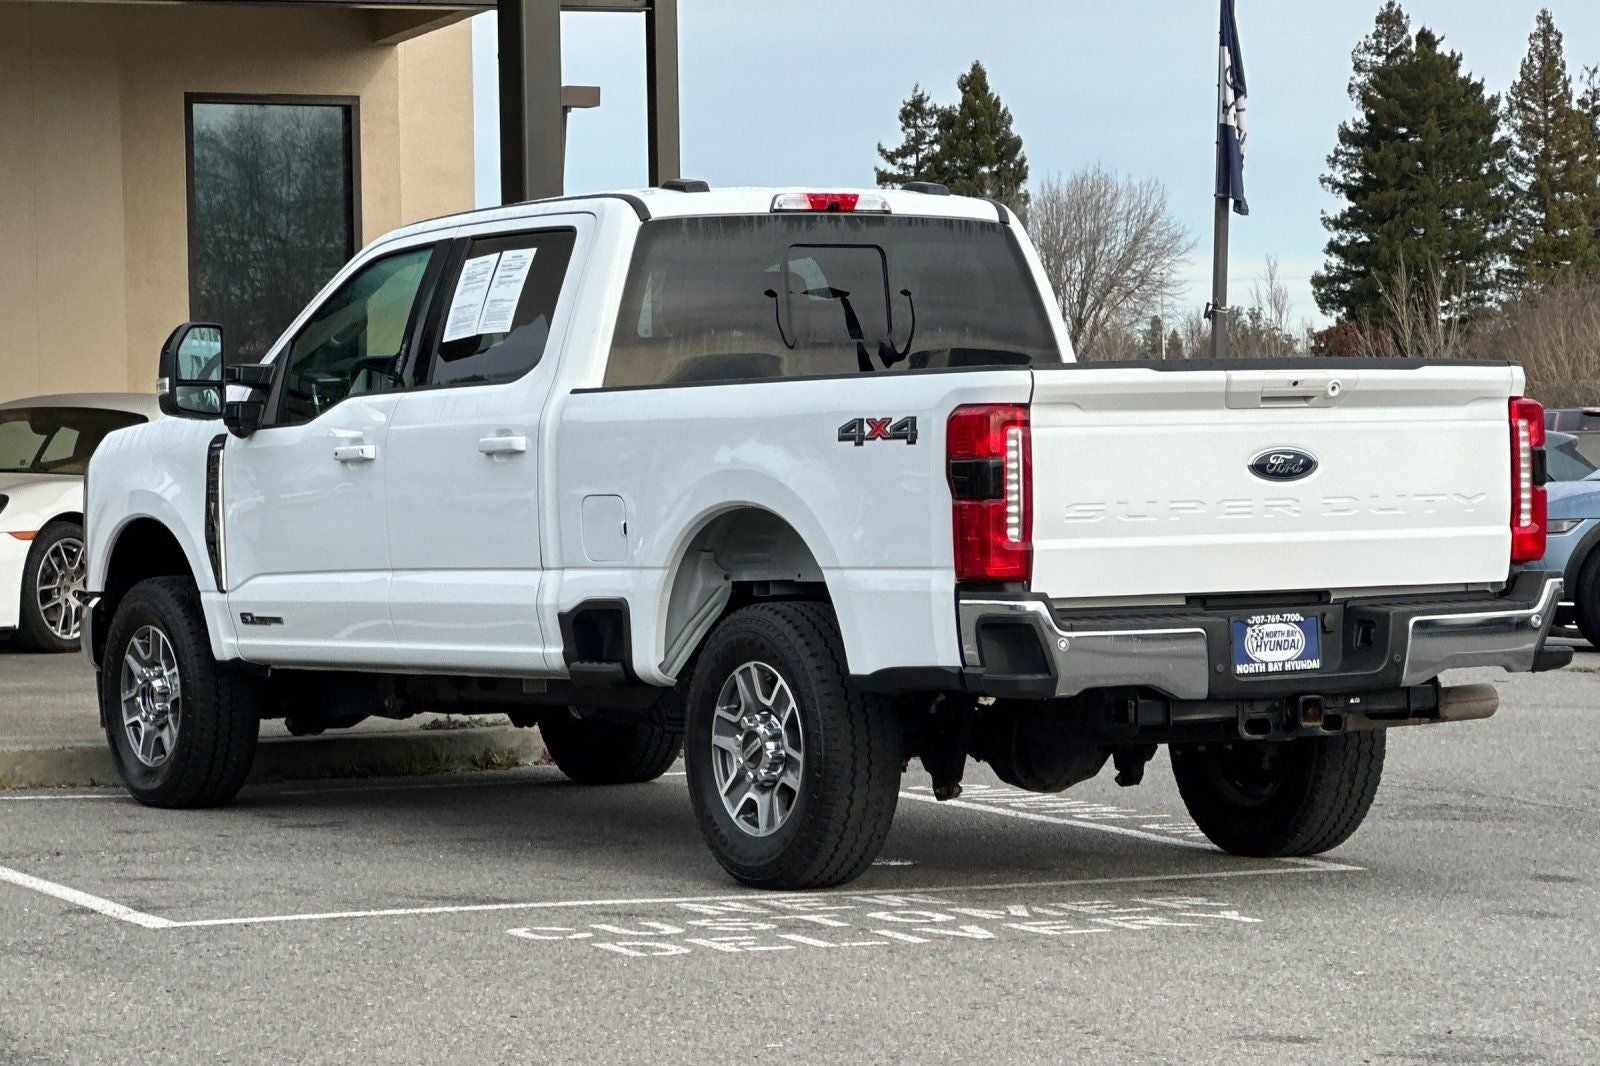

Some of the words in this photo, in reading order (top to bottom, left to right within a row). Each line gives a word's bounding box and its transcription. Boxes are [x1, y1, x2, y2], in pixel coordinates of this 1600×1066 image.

[1065, 498, 1301, 523] SUPER
[1321, 492, 1487, 516] DUTY
[1251, 613, 1300, 624] 707-769-7700
[1265, 630, 1285, 639] NORTH
[1286, 629, 1298, 637] BAY
[1255, 639, 1300, 652] HYUNDAI
[1236, 662, 1266, 674] NORTH
[1267, 661, 1283, 672] BAY
[1284, 659, 1320, 671] HYUNDAI
[676, 893, 957, 916] NEW
[505, 896, 1236, 941] CUSTOMER
[592, 910, 1265, 957] DELIVERY
